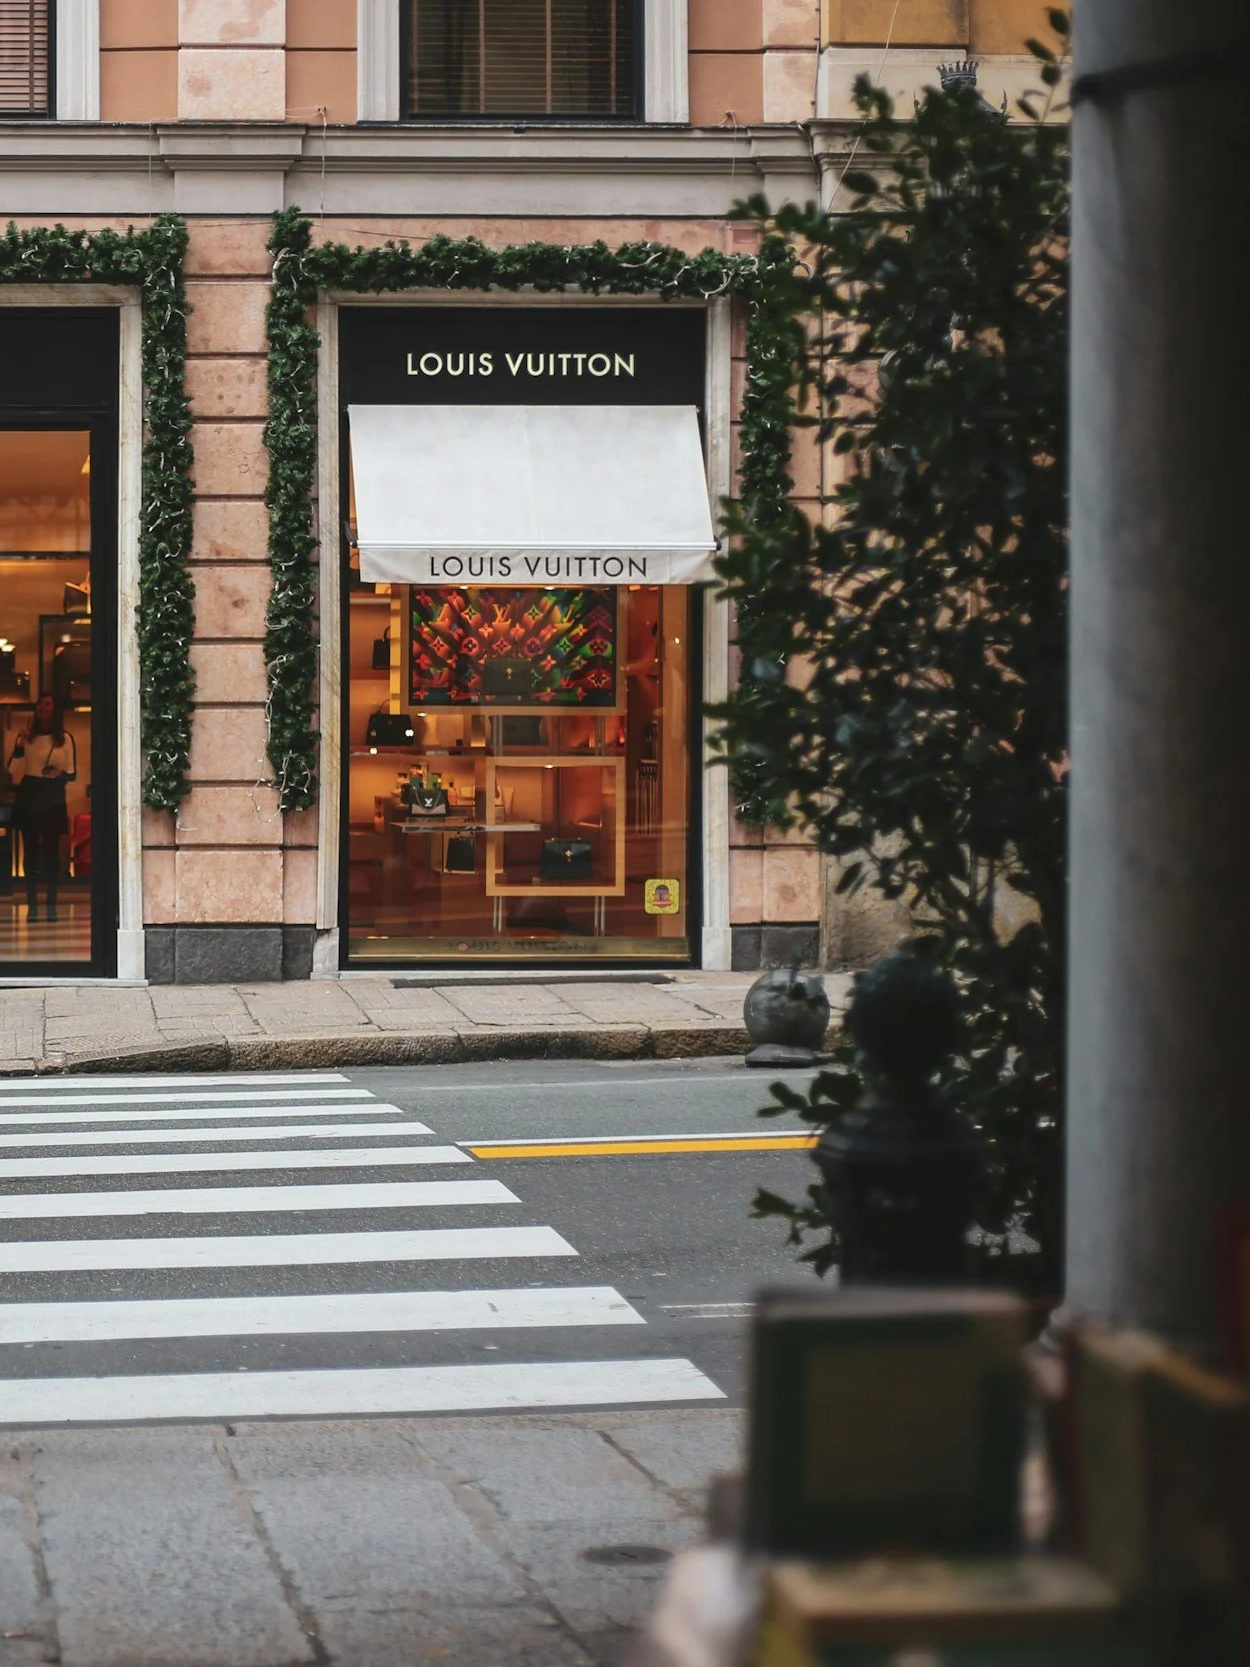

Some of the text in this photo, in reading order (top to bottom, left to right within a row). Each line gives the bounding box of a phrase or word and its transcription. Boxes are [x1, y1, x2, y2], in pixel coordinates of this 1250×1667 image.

[406, 352, 635, 377] LOUIS VUITTON
[430, 556, 647, 578] LOUIS VUITTON
